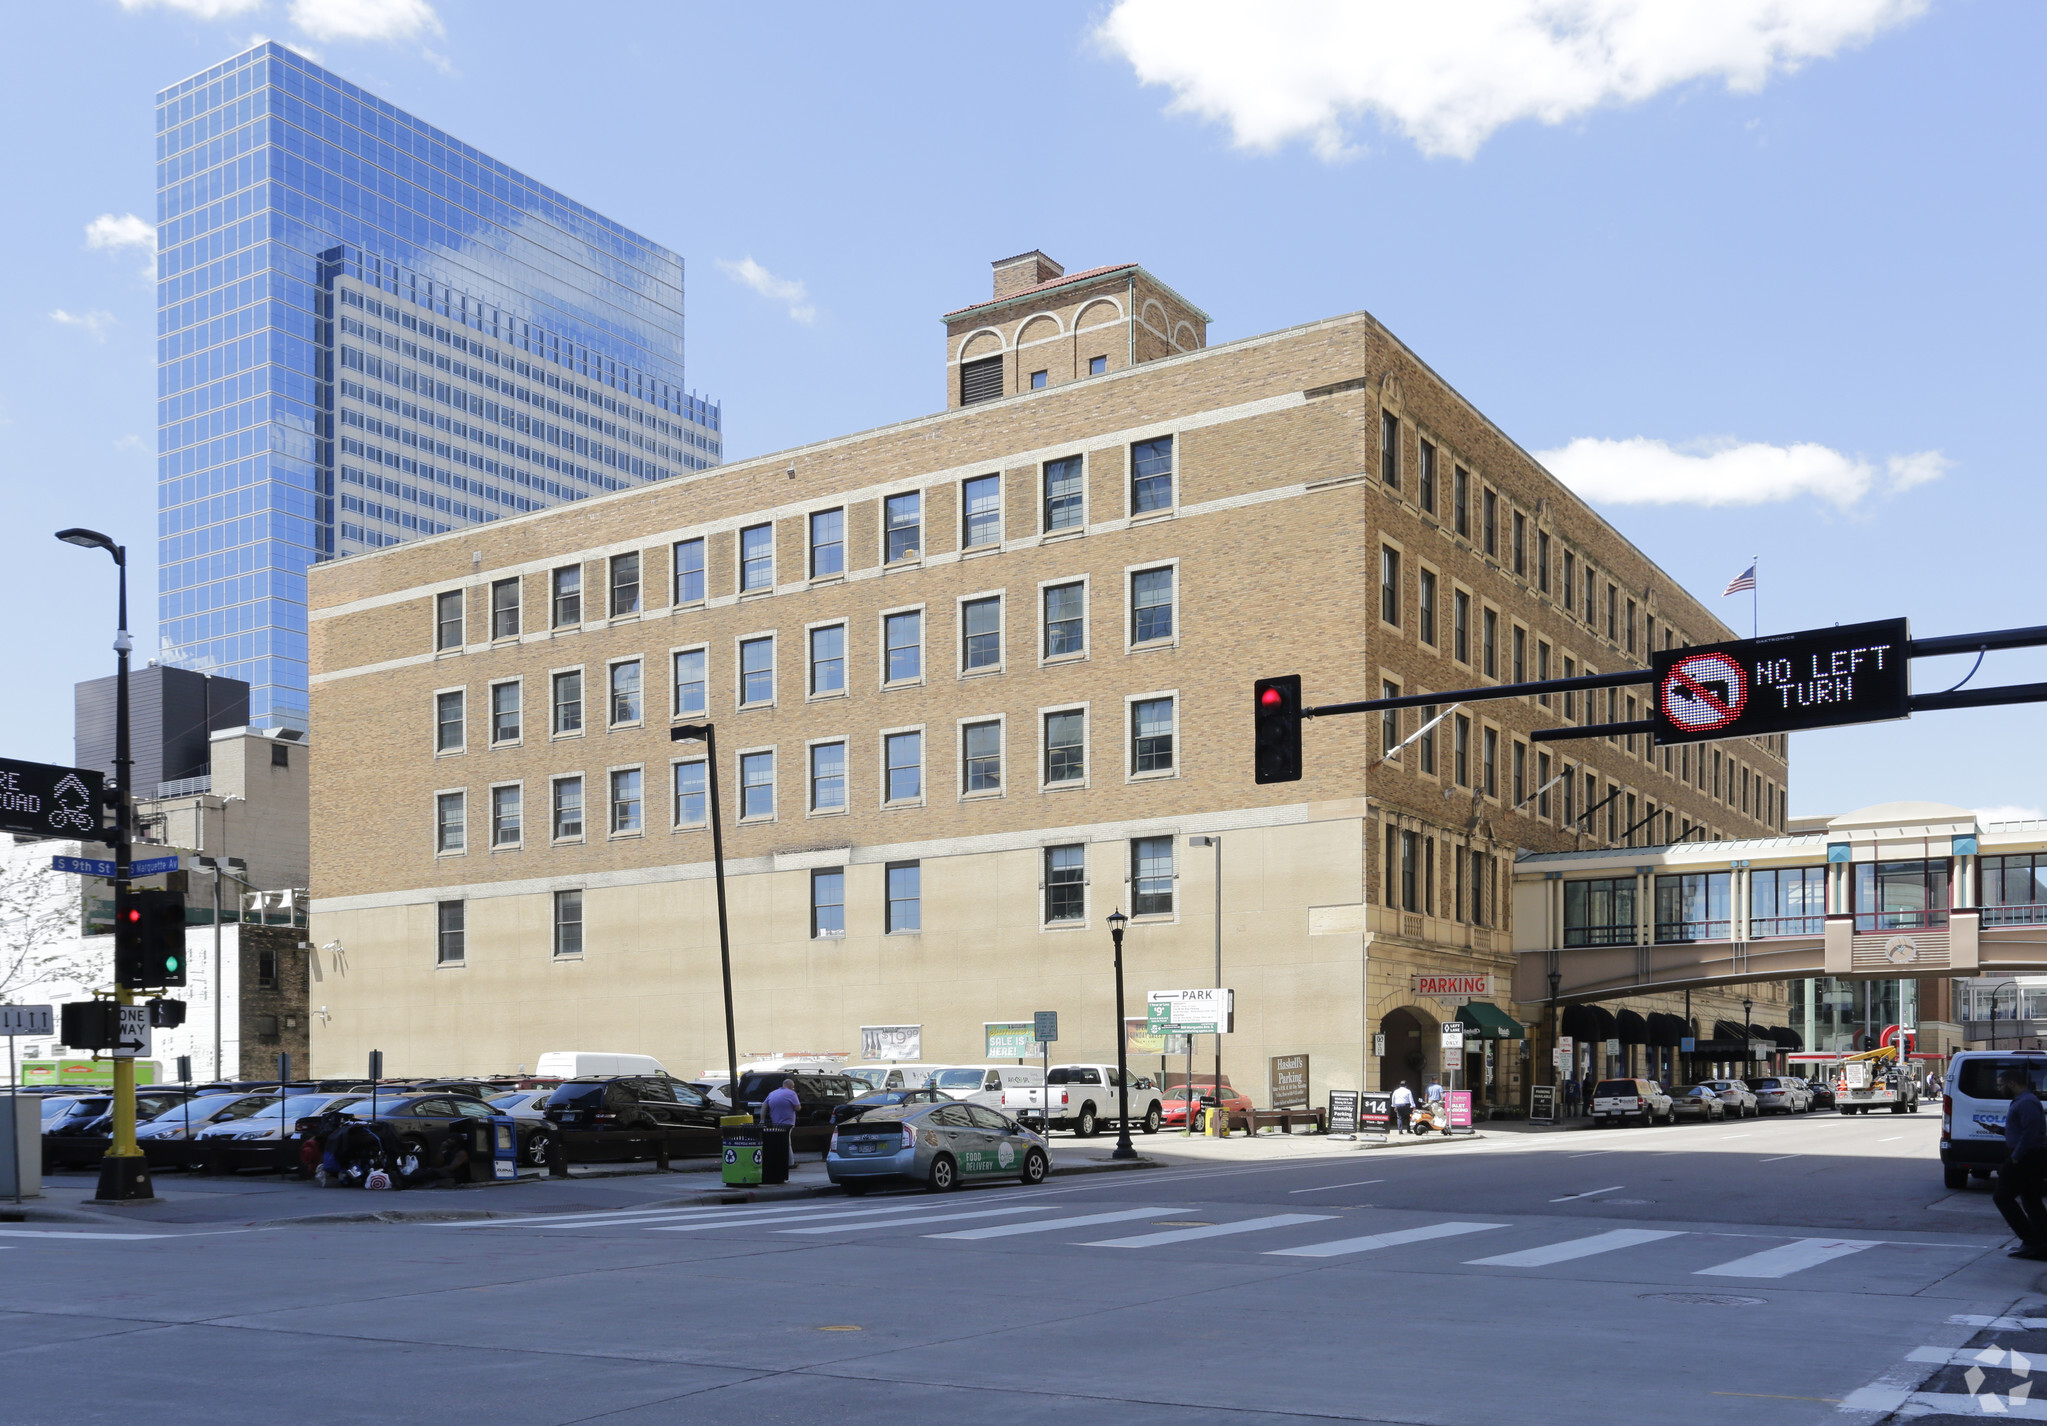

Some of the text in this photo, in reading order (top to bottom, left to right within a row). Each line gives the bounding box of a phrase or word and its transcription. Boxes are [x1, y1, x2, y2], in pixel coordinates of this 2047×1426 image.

[1755, 635, 1796, 645] DAKTRONICS
[1756, 644, 1891, 686] NO LEFT
[1775, 676, 1853, 709] TURN
[0, 791, 41, 813] OAD
[57, 859, 111, 874] S 9th St
[130, 859, 178, 874] S Marquette Av
[1419, 977, 1486, 993] PARKING
[1182, 990, 1213, 1000] PARK
[120, 1010, 145, 1022] ONE
[120, 1024, 146, 1035] WAY
[988, 1026, 1030, 1037] Summer
[989, 1036, 1025, 1046] SALE IS
[989, 1046, 1017, 1057] HERE!
[1277, 1056, 1303, 1070] Haskell's
[1278, 1072, 1303, 1085] Parking
[1364, 1100, 1387, 1114] $14
[1973, 1114, 2008, 1123] ECOLA
[965, 1152, 982, 1162] FOOD
[965, 1161, 994, 1172] DELIVERY
